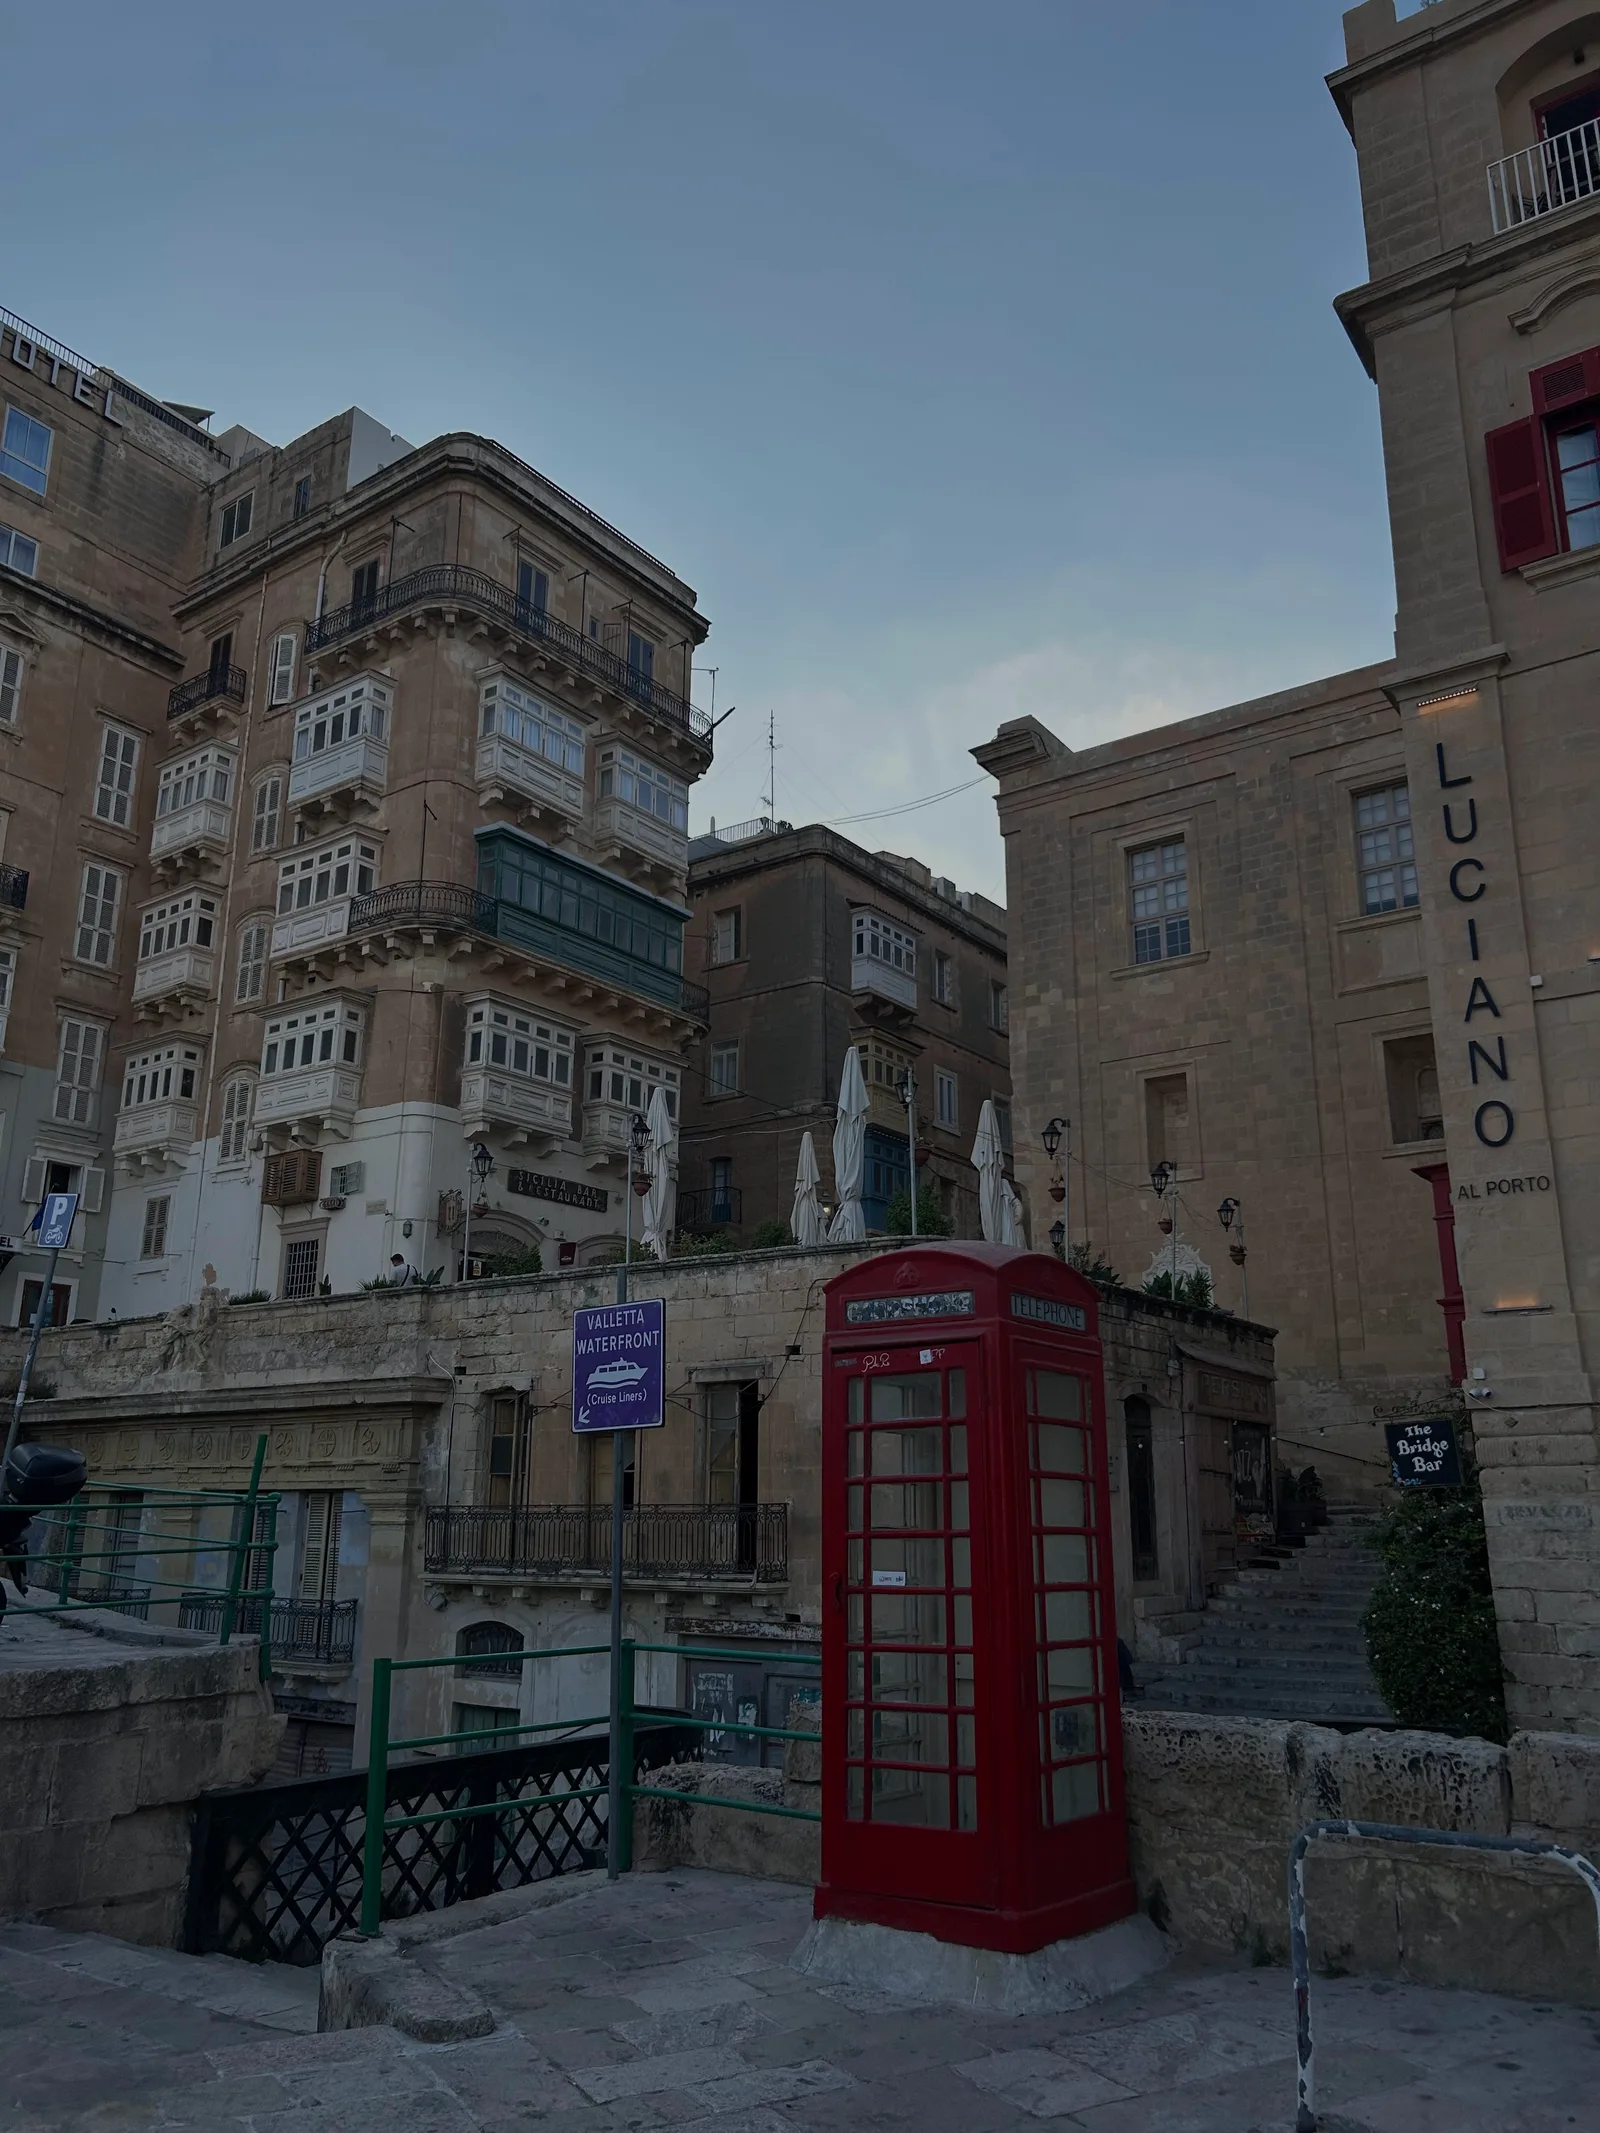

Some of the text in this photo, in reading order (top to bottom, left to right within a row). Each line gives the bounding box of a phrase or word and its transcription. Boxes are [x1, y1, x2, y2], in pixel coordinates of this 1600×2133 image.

[0, 322, 123, 427] OTEL
[1436, 742, 1514, 1148] LUCIANO
[518, 1171, 597, 1198] SICILIA BAR
[1458, 1175, 1550, 1200] AL PORTO
[50, 1196, 68, 1225] P
[587, 1308, 645, 1331] VALLETTA
[1013, 1295, 1082, 1327] TELEPHONE
[577, 1330, 660, 1355] WATERFRONT
[586, 1388, 647, 1406] (Cruise Liners)
[1404, 1424, 1433, 1438] The
[1396, 1438, 1449, 1458] Bridge
[1412, 1456, 1443, 1472] Bar
